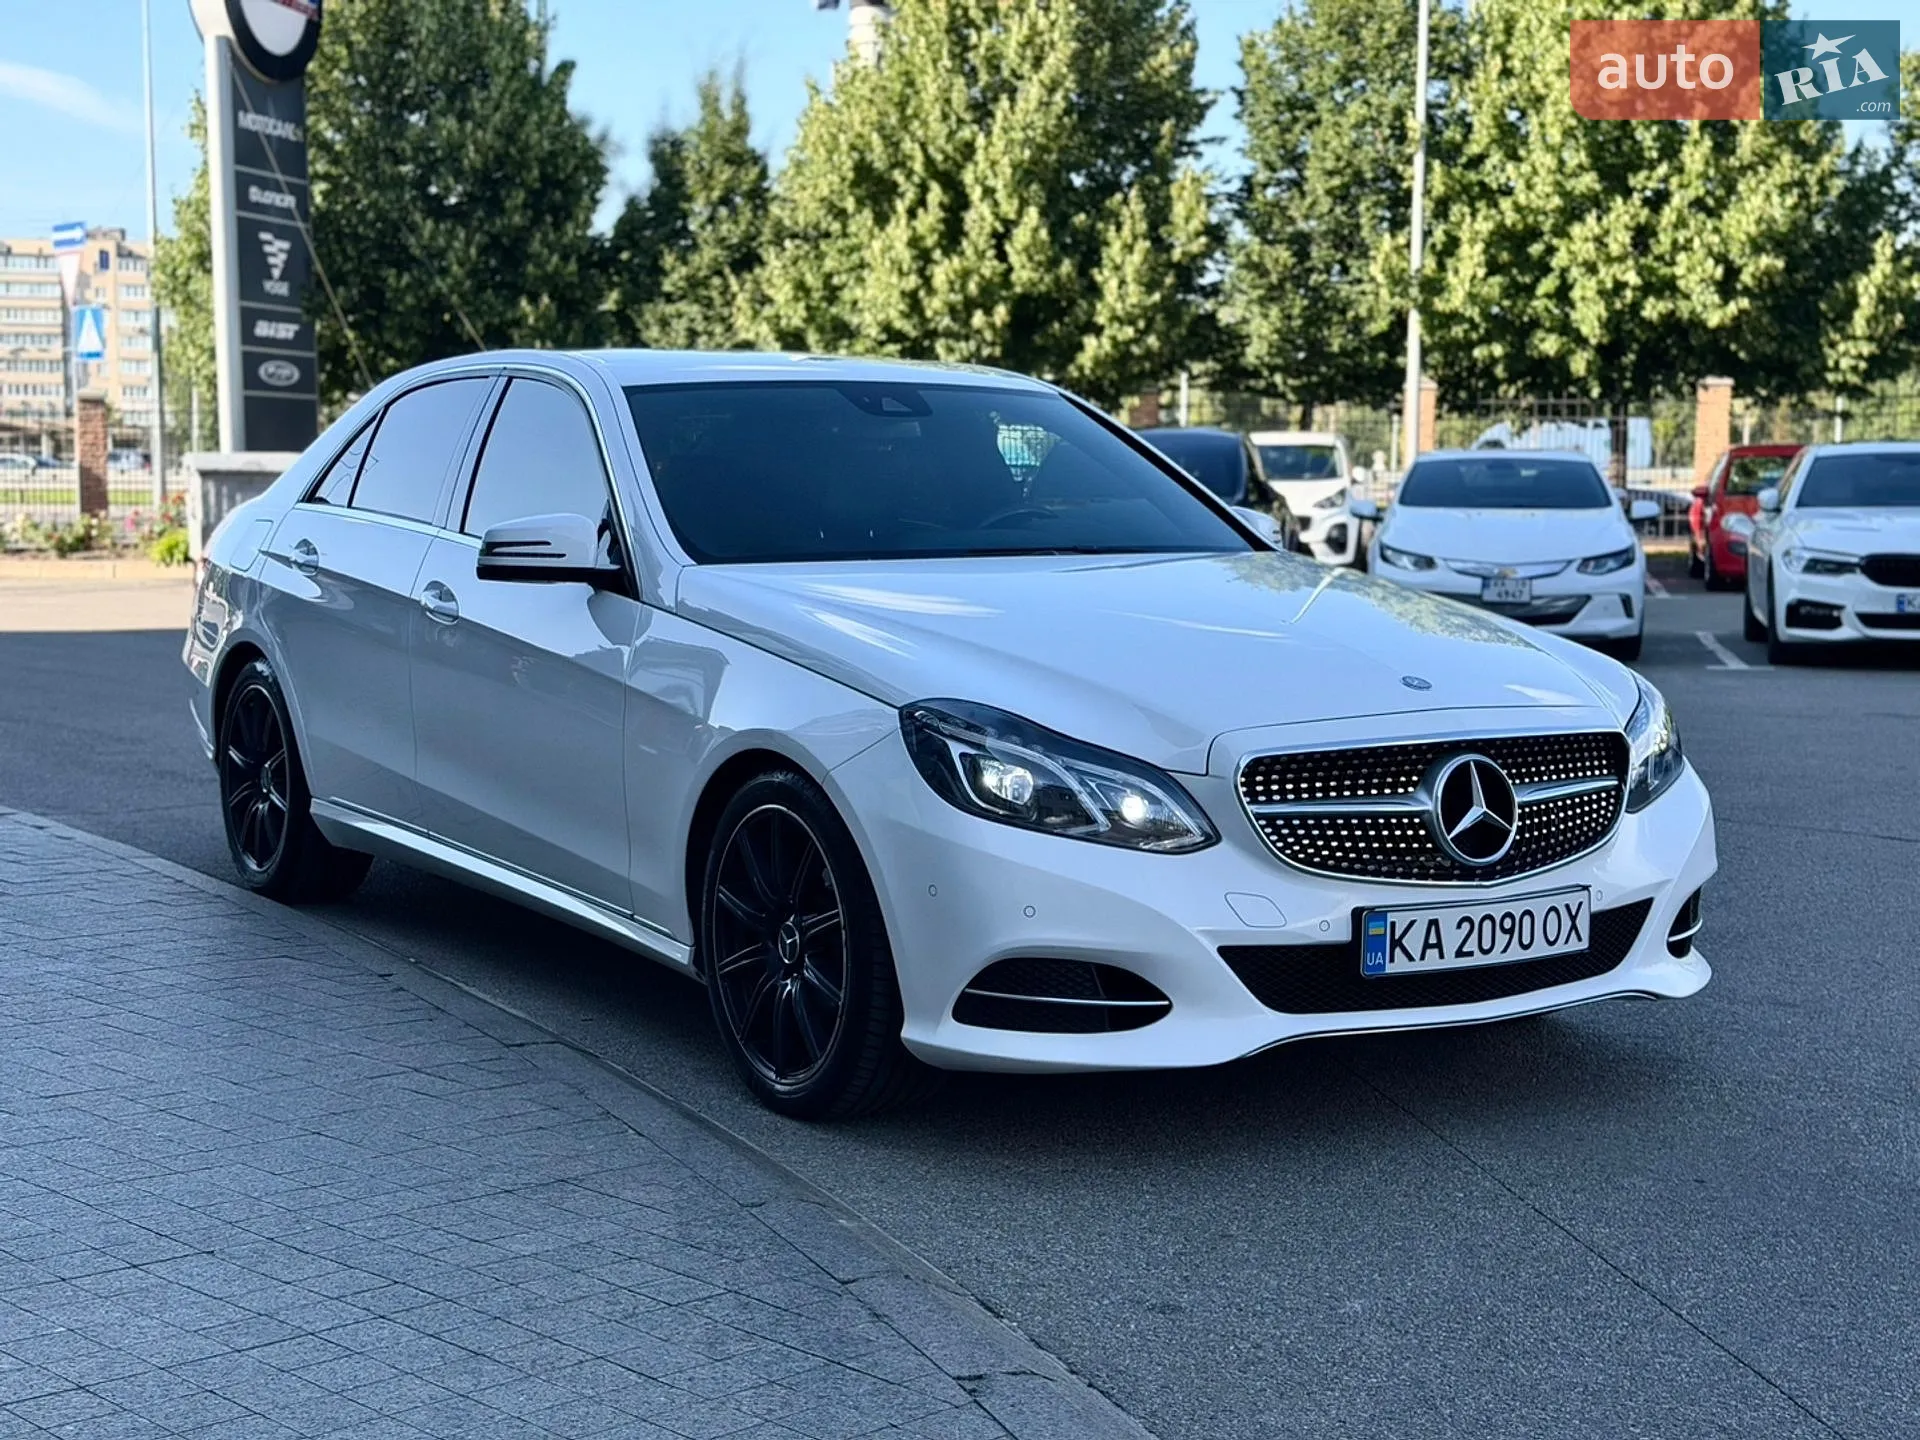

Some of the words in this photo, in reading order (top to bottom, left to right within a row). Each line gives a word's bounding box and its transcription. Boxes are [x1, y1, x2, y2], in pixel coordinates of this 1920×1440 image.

[1388, 918, 1445, 963] KA
[1455, 909, 1535, 959] 2090
[1542, 901, 1584, 946] OX
[1366, 952, 1384, 966] UA
